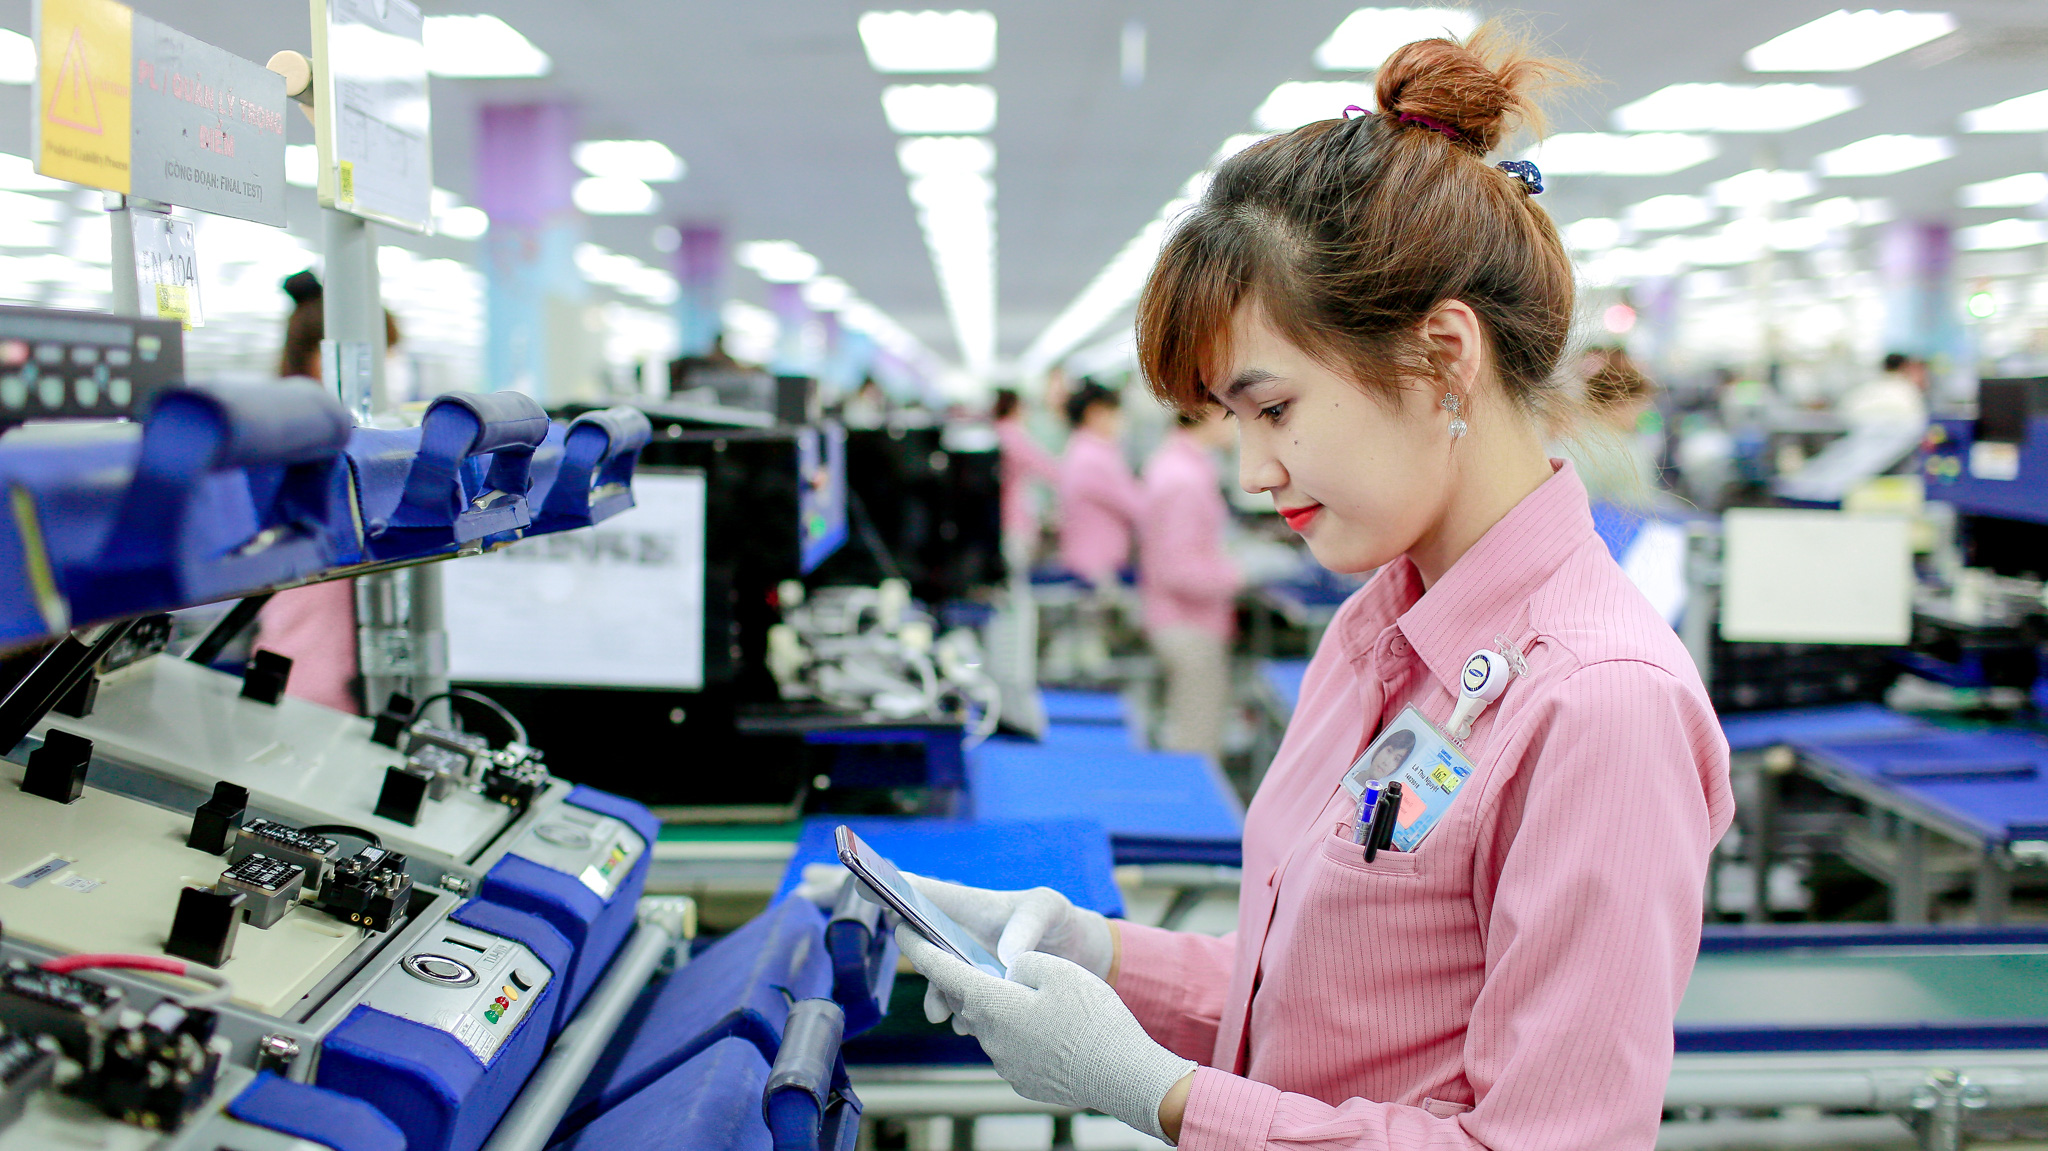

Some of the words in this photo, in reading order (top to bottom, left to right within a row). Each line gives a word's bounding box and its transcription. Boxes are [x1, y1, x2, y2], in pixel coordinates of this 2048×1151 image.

[138, 59, 159, 90] PL
[172, 71, 214, 112] QUẢN
[217, 87, 236, 120] LÝ
[239, 98, 283, 135] TRỌNG
[199, 118, 235, 158] ĐIỂM
[104, 155, 129, 171] Process
[164, 159, 192, 183] (CÔNG
[194, 169, 219, 191] ĐOẠN:
[220, 176, 242, 195] FINAL
[243, 180, 263, 203] TEST)
